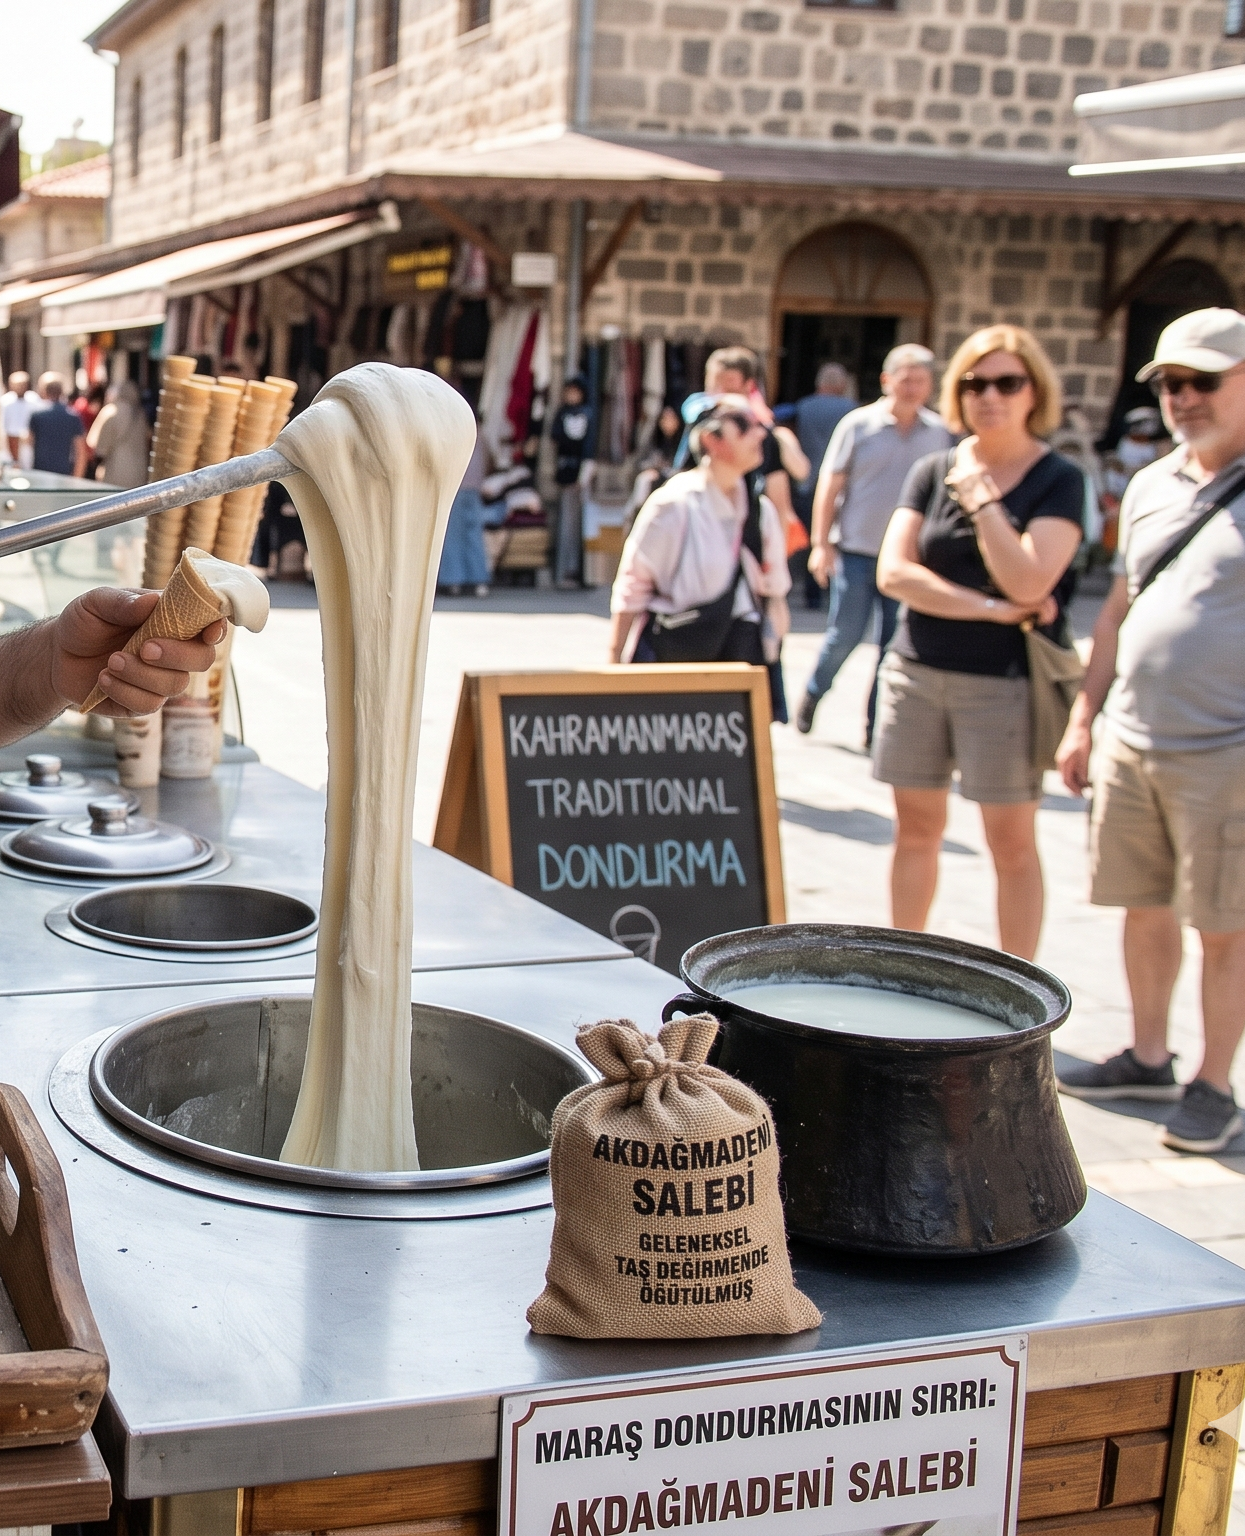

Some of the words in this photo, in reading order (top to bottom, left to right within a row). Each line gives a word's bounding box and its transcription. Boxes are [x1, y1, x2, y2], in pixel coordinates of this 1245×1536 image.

[508, 711, 749, 758] KAHRAMANMARAŞ
[525, 777, 740, 819] TRADITIONAL
[538, 838, 747, 892] DONDURMA
[592, 1113, 772, 1171] AKDAĞMADENİ
[632, 1160, 755, 1217] SALEBİ
[614, 1254, 651, 1281] TAŞ
[656, 1244, 769, 1280] DEĞİRMENDE
[639, 1225, 752, 1254] GELENEKSEL
[535, 1421, 643, 1464] MARAŞ
[654, 1386, 902, 1450] DONDURMASININ
[911, 1378, 997, 1417] SIRRI:
[549, 1456, 835, 1536] AKDAĞMADENİ
[849, 1437, 978, 1503] SALEBİ
